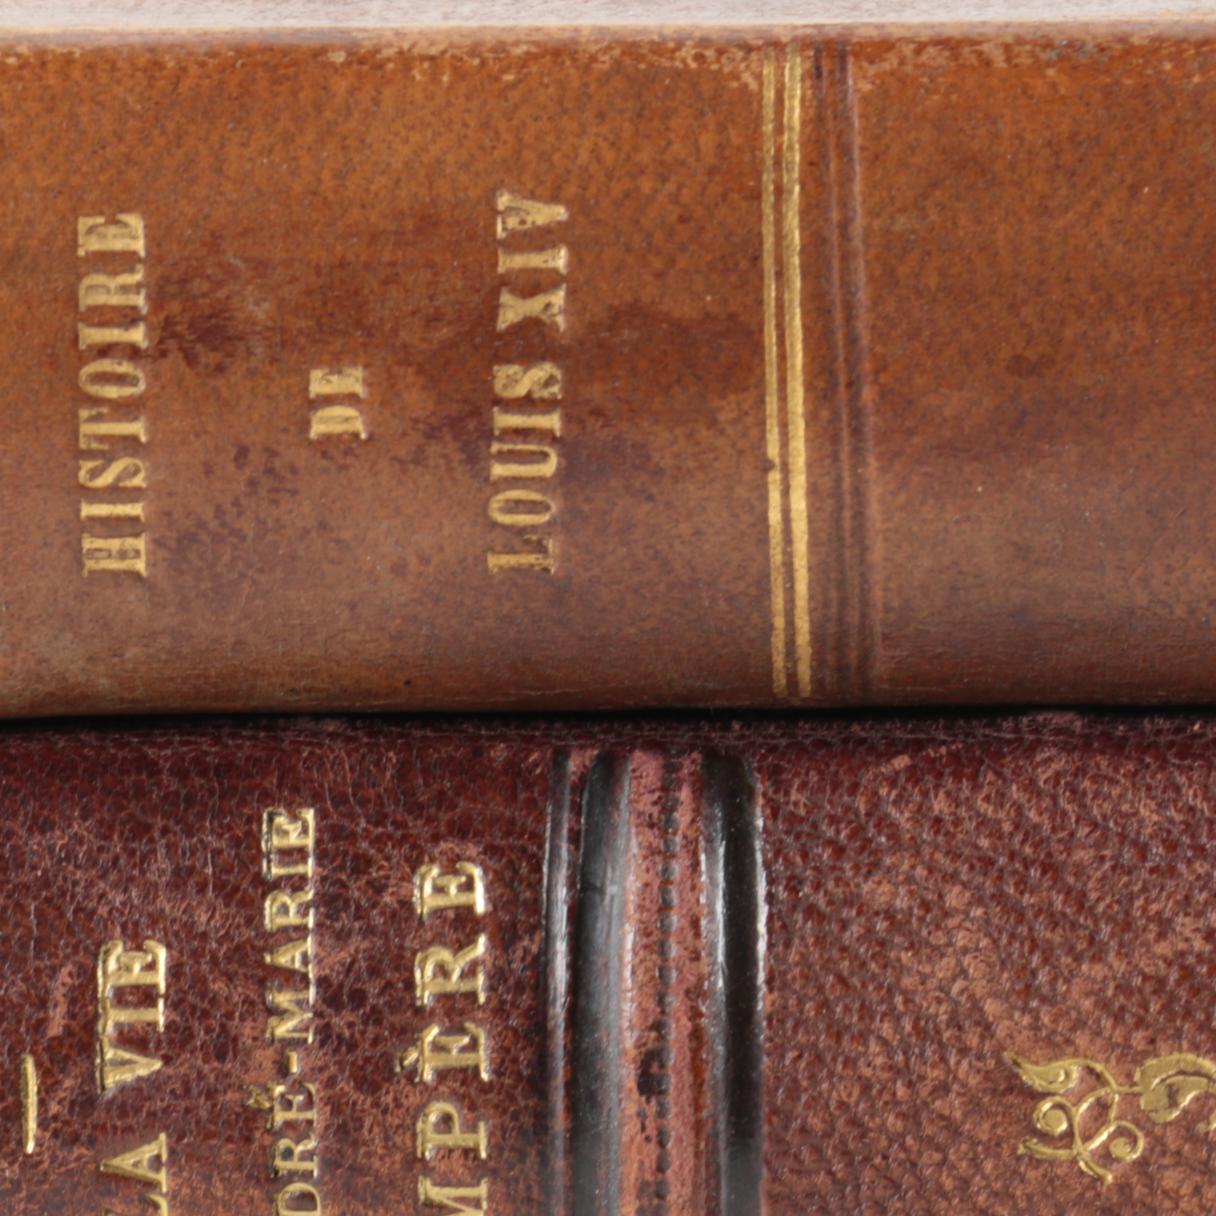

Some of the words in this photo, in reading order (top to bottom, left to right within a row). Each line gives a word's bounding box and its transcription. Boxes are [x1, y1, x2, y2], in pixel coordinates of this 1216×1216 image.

[496, 190, 569, 332] XIV
[78, 213, 148, 578] HISTOIRE
[309, 366, 369, 440] DE
[487, 361, 563, 574] LOUIS
[97, 940, 168, 1094] VIE
